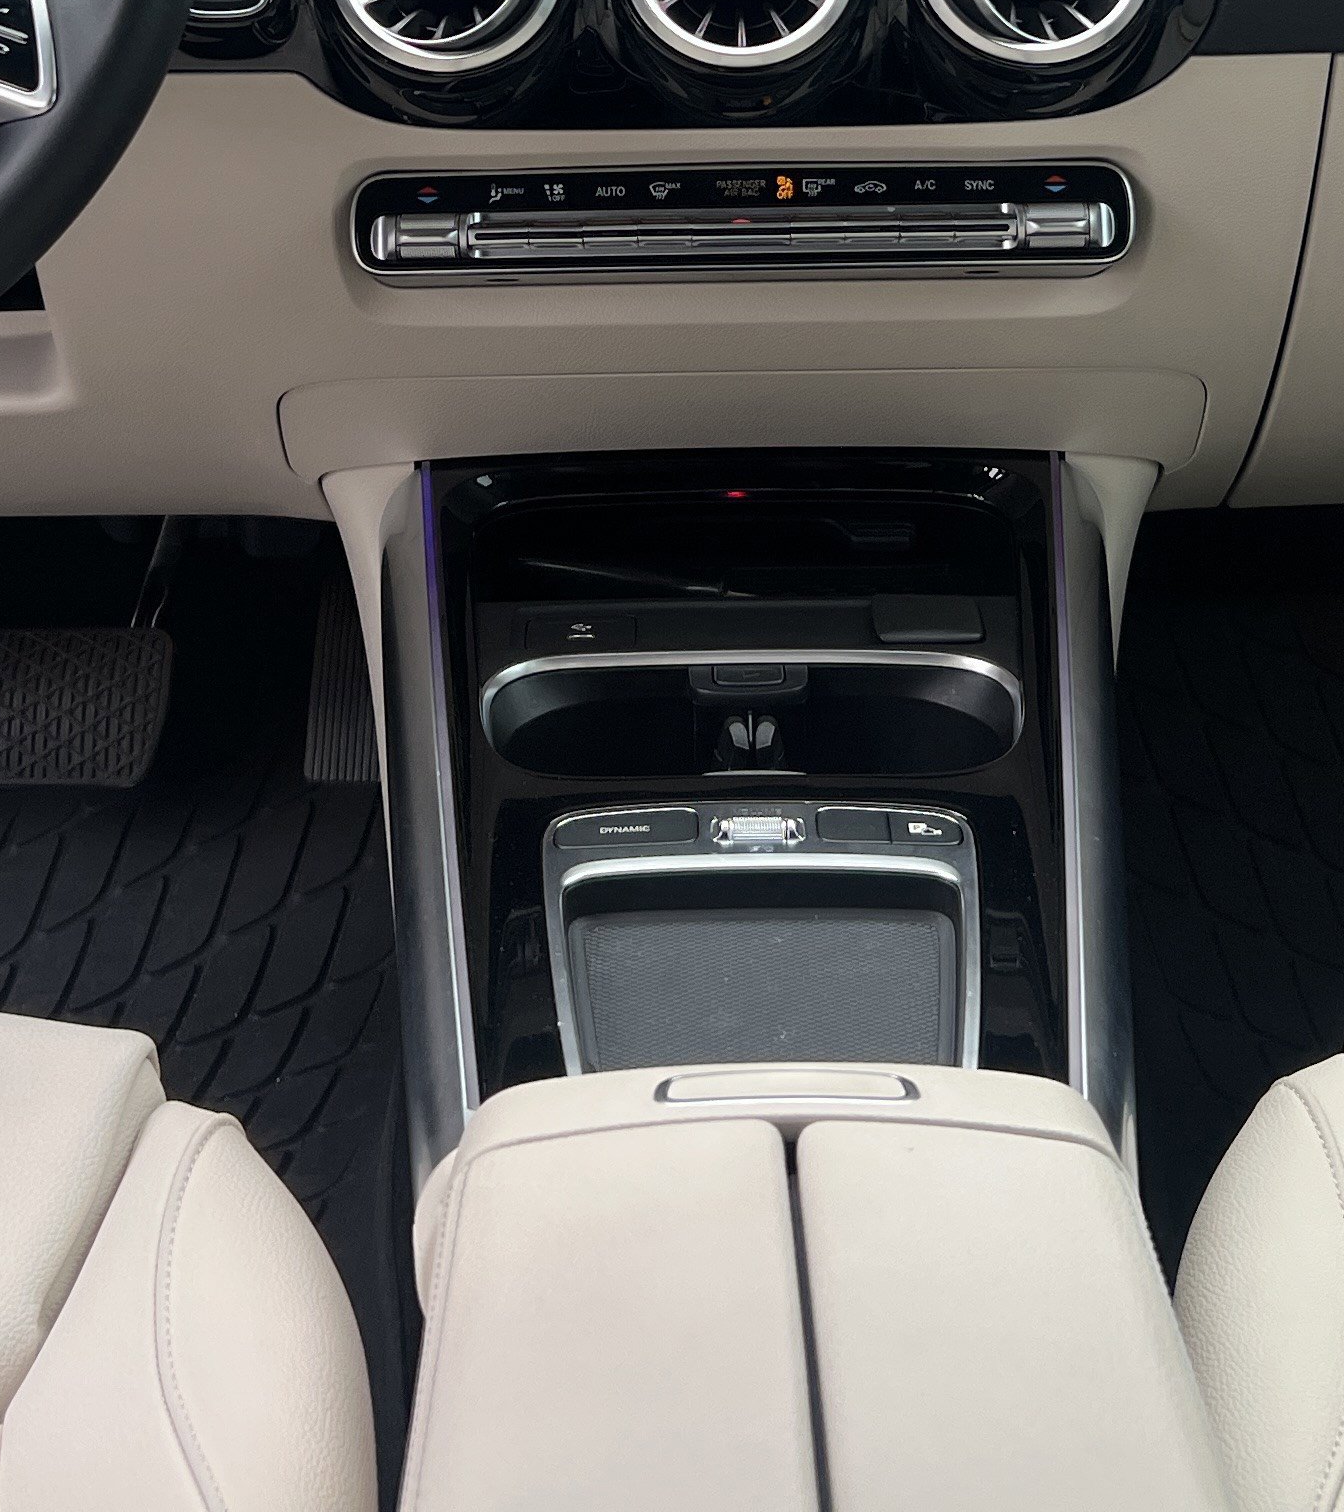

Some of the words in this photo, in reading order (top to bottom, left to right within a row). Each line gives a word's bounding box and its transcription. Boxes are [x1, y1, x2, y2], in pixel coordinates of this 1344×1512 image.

[716, 179, 766, 189] PASSENGER
[914, 179, 936, 190] A/C
[964, 179, 995, 191] SYNC
[503, 187, 525, 195] MENU
[595, 186, 626, 197] AUTO
[599, 824, 651, 834] DYNAMIC
